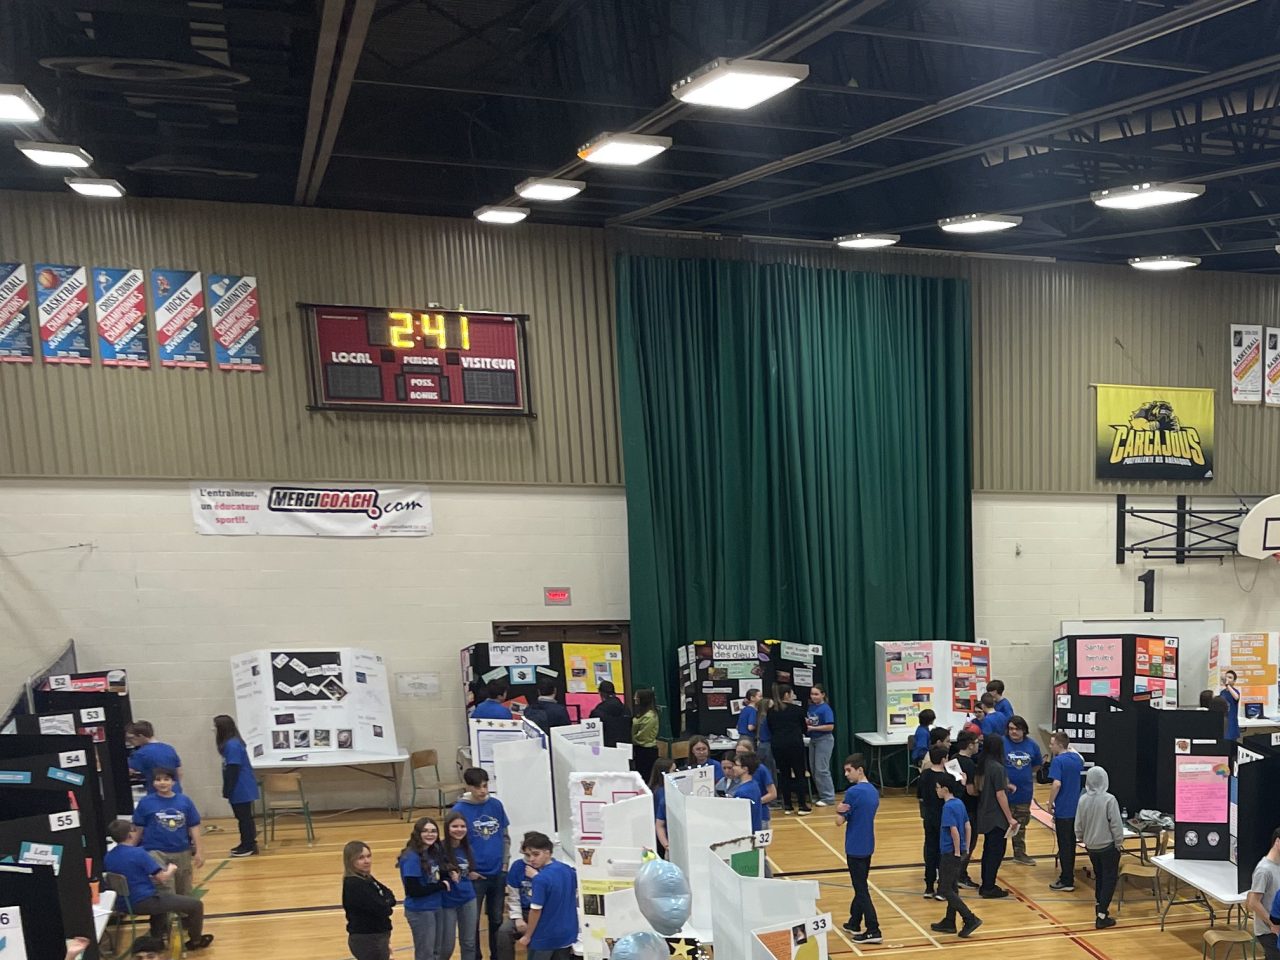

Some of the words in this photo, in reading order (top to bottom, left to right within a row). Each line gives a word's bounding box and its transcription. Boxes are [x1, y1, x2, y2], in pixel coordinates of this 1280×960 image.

[41, 277, 84, 316] BASKETBALL
[164, 287, 193, 315] HOCKEY
[214, 280, 252, 317] BADMINTON
[331, 351, 373, 364] LOCAL
[461, 357, 516, 370] VISITEUR
[1108, 425, 1206, 466] CARCAJOUS
[214, 501, 260, 511] éducateur
[273, 491, 373, 509] MERCICOACH
[383, 500, 423, 513] com
[1138, 568, 1156, 613] 1
[713, 642, 756, 652] Nourriture
[514, 655, 528, 664] 3D
[714, 651, 731, 659] des
[54, 678, 66, 686] 52
[86, 711, 99, 720] 53
[66, 755, 80, 764] 54
[699, 770, 707, 778] 31
[57, 816, 73, 827] 55
[759, 832, 770, 844] 32
[812, 919, 827, 931] 33
